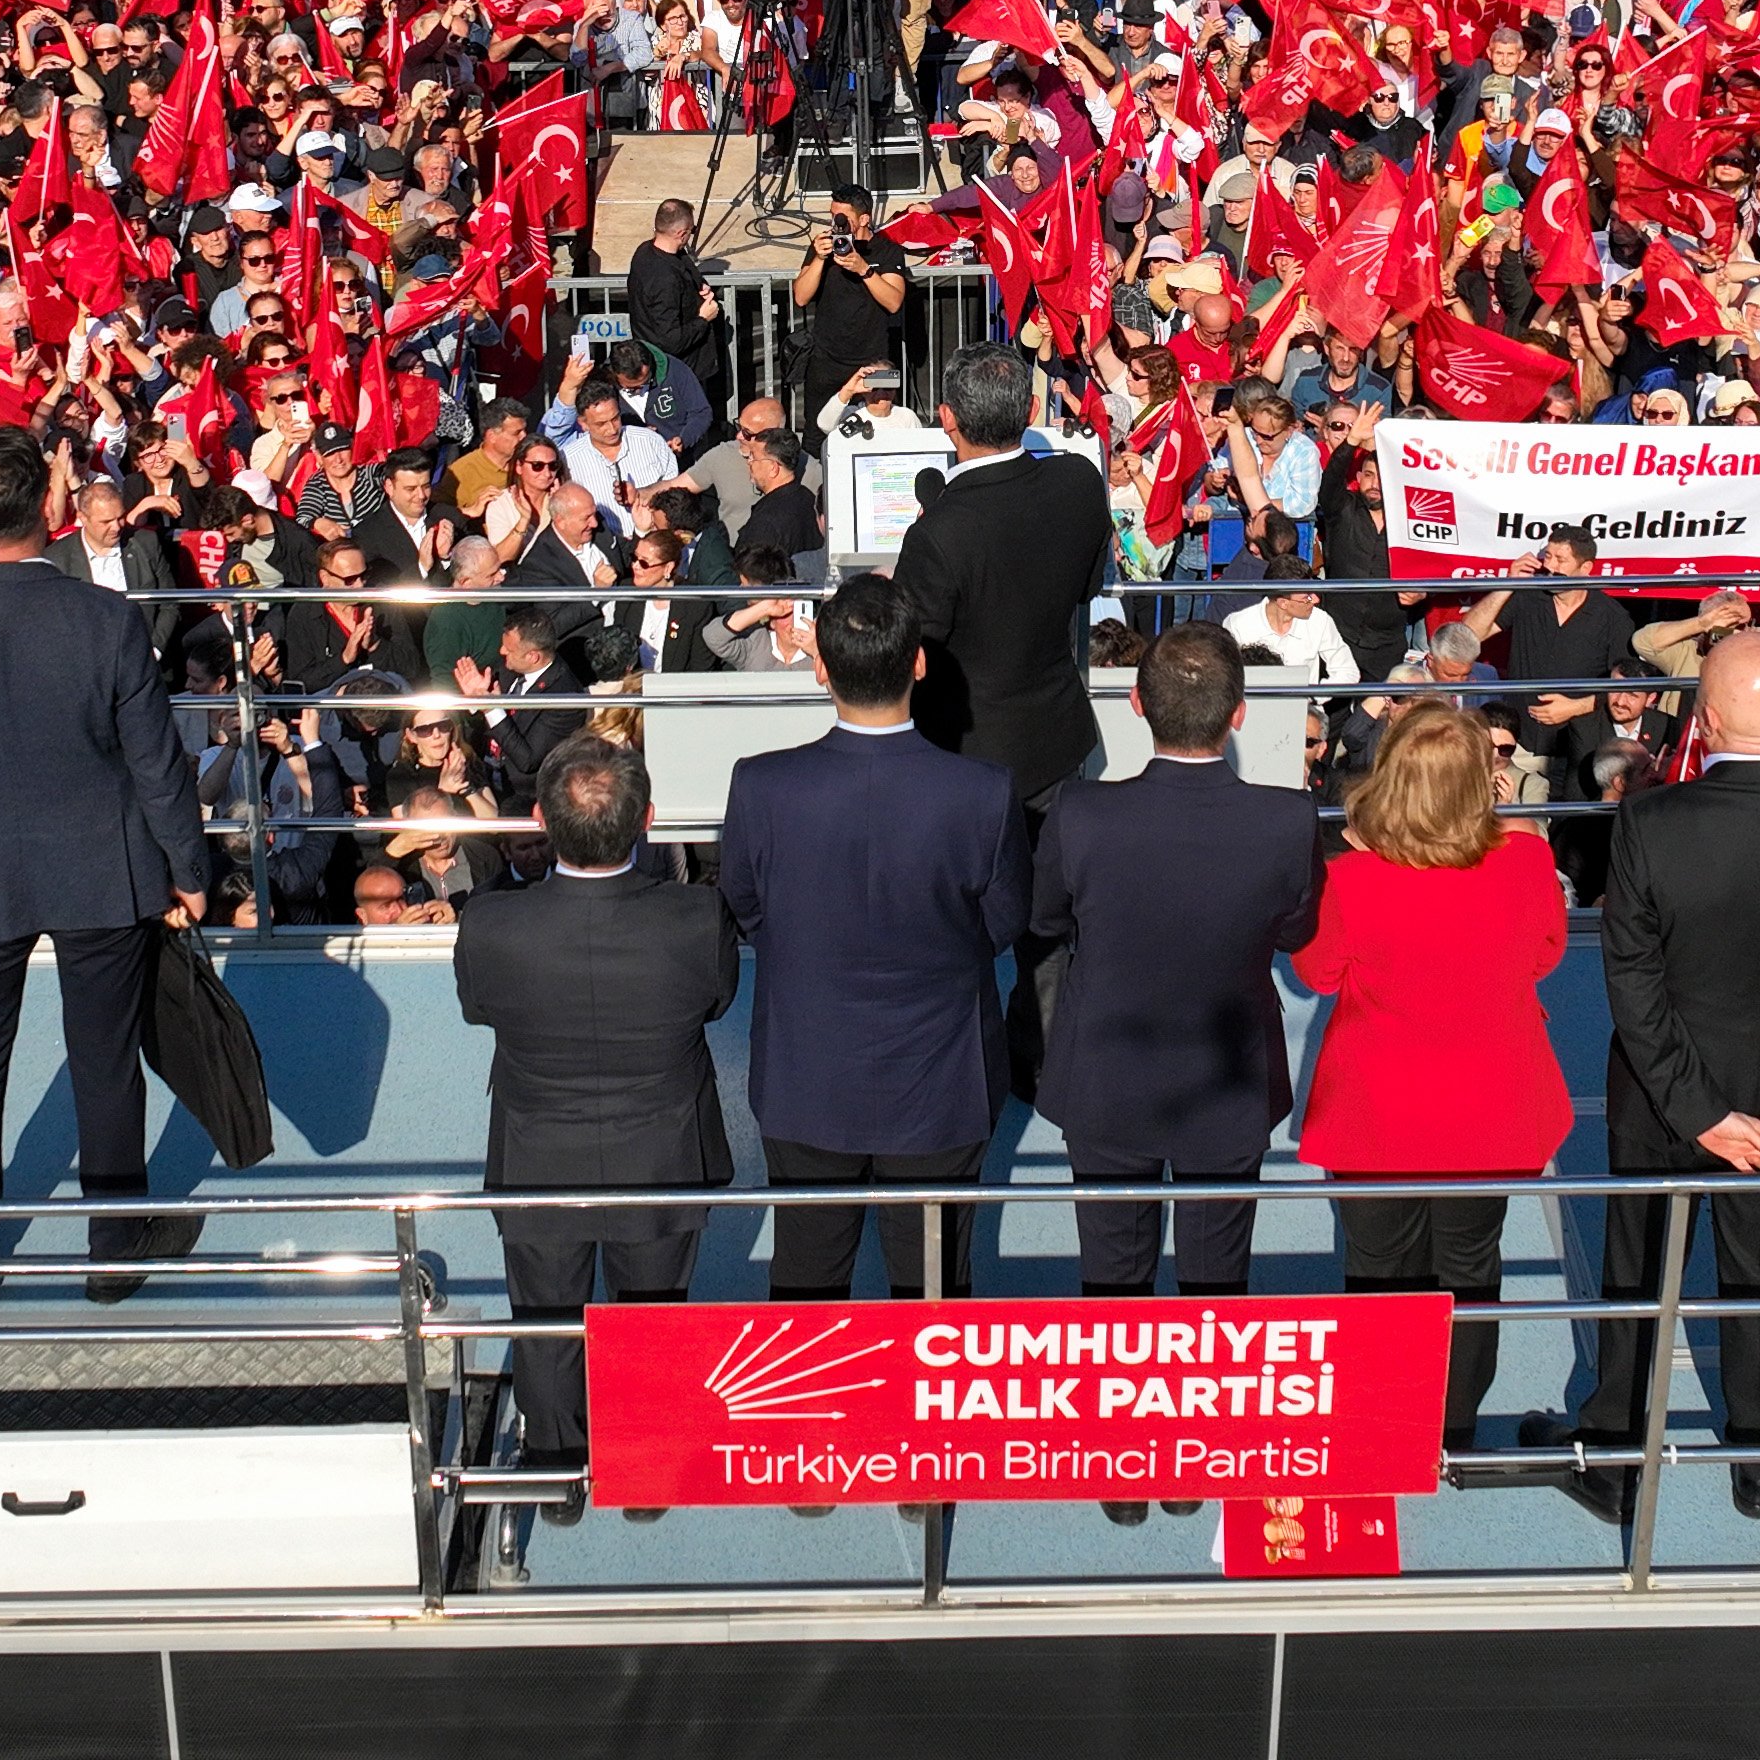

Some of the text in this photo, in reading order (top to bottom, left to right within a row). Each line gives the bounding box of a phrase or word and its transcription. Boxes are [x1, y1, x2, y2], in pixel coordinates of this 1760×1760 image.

[1426, 364, 1490, 409] CHP
[1527, 443, 1627, 480] Genel
[1413, 523, 1453, 540] CHP
[1589, 509, 1747, 542] Geldiniz
[914, 1310, 1338, 1369] CUMHURİYET
[914, 1365, 1336, 1423] HALK PARTİSİ
[712, 1434, 1331, 1493] Türkiye'nin Birinci Partisi
